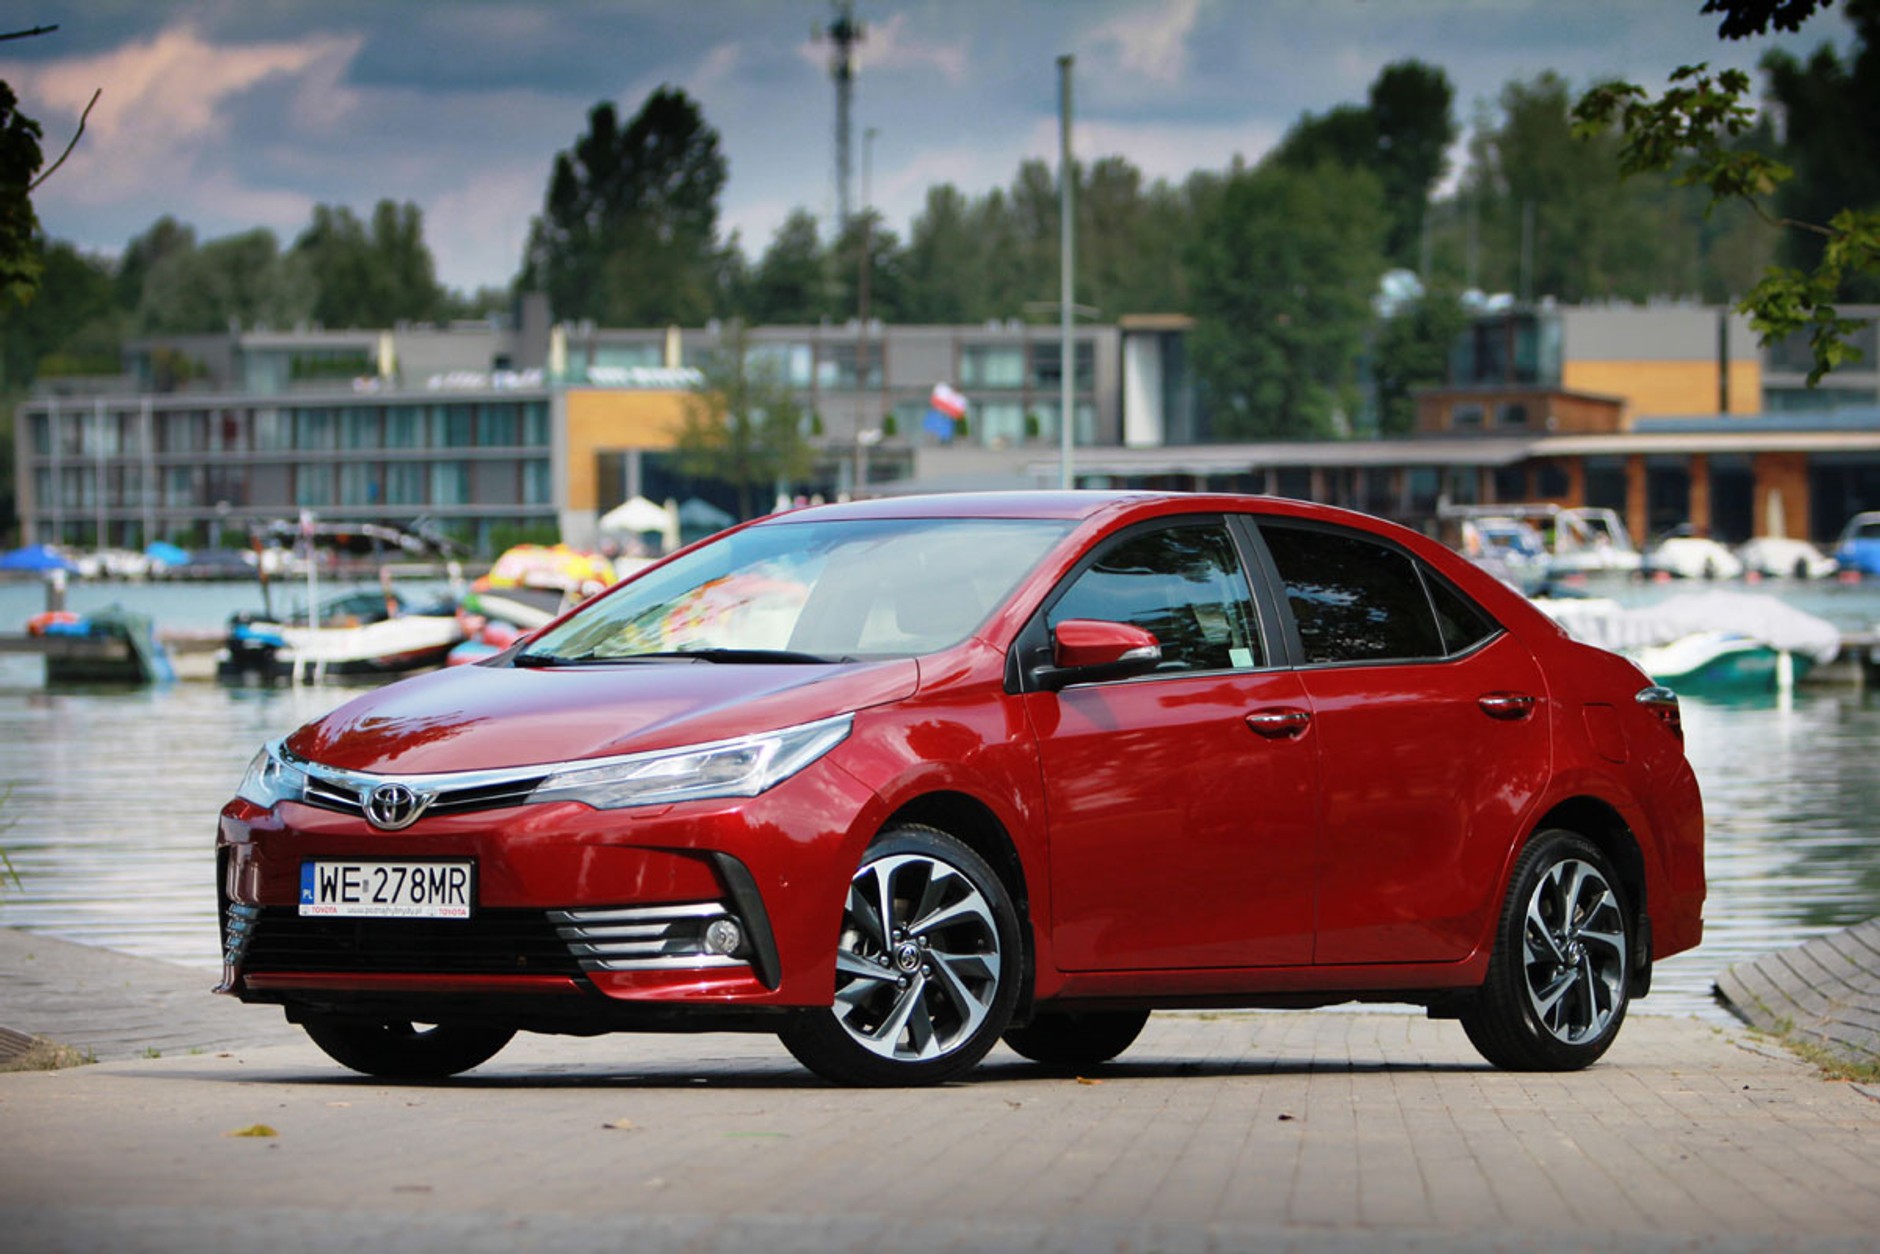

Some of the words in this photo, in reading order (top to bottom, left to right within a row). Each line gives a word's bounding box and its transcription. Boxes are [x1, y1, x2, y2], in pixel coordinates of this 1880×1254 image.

[320, 866, 361, 902] WE
[372, 867, 467, 904] 278MR
[302, 889, 314, 900] PL
[311, 906, 338, 914] TOYOTA
[438, 908, 467, 916] TOYOTA
